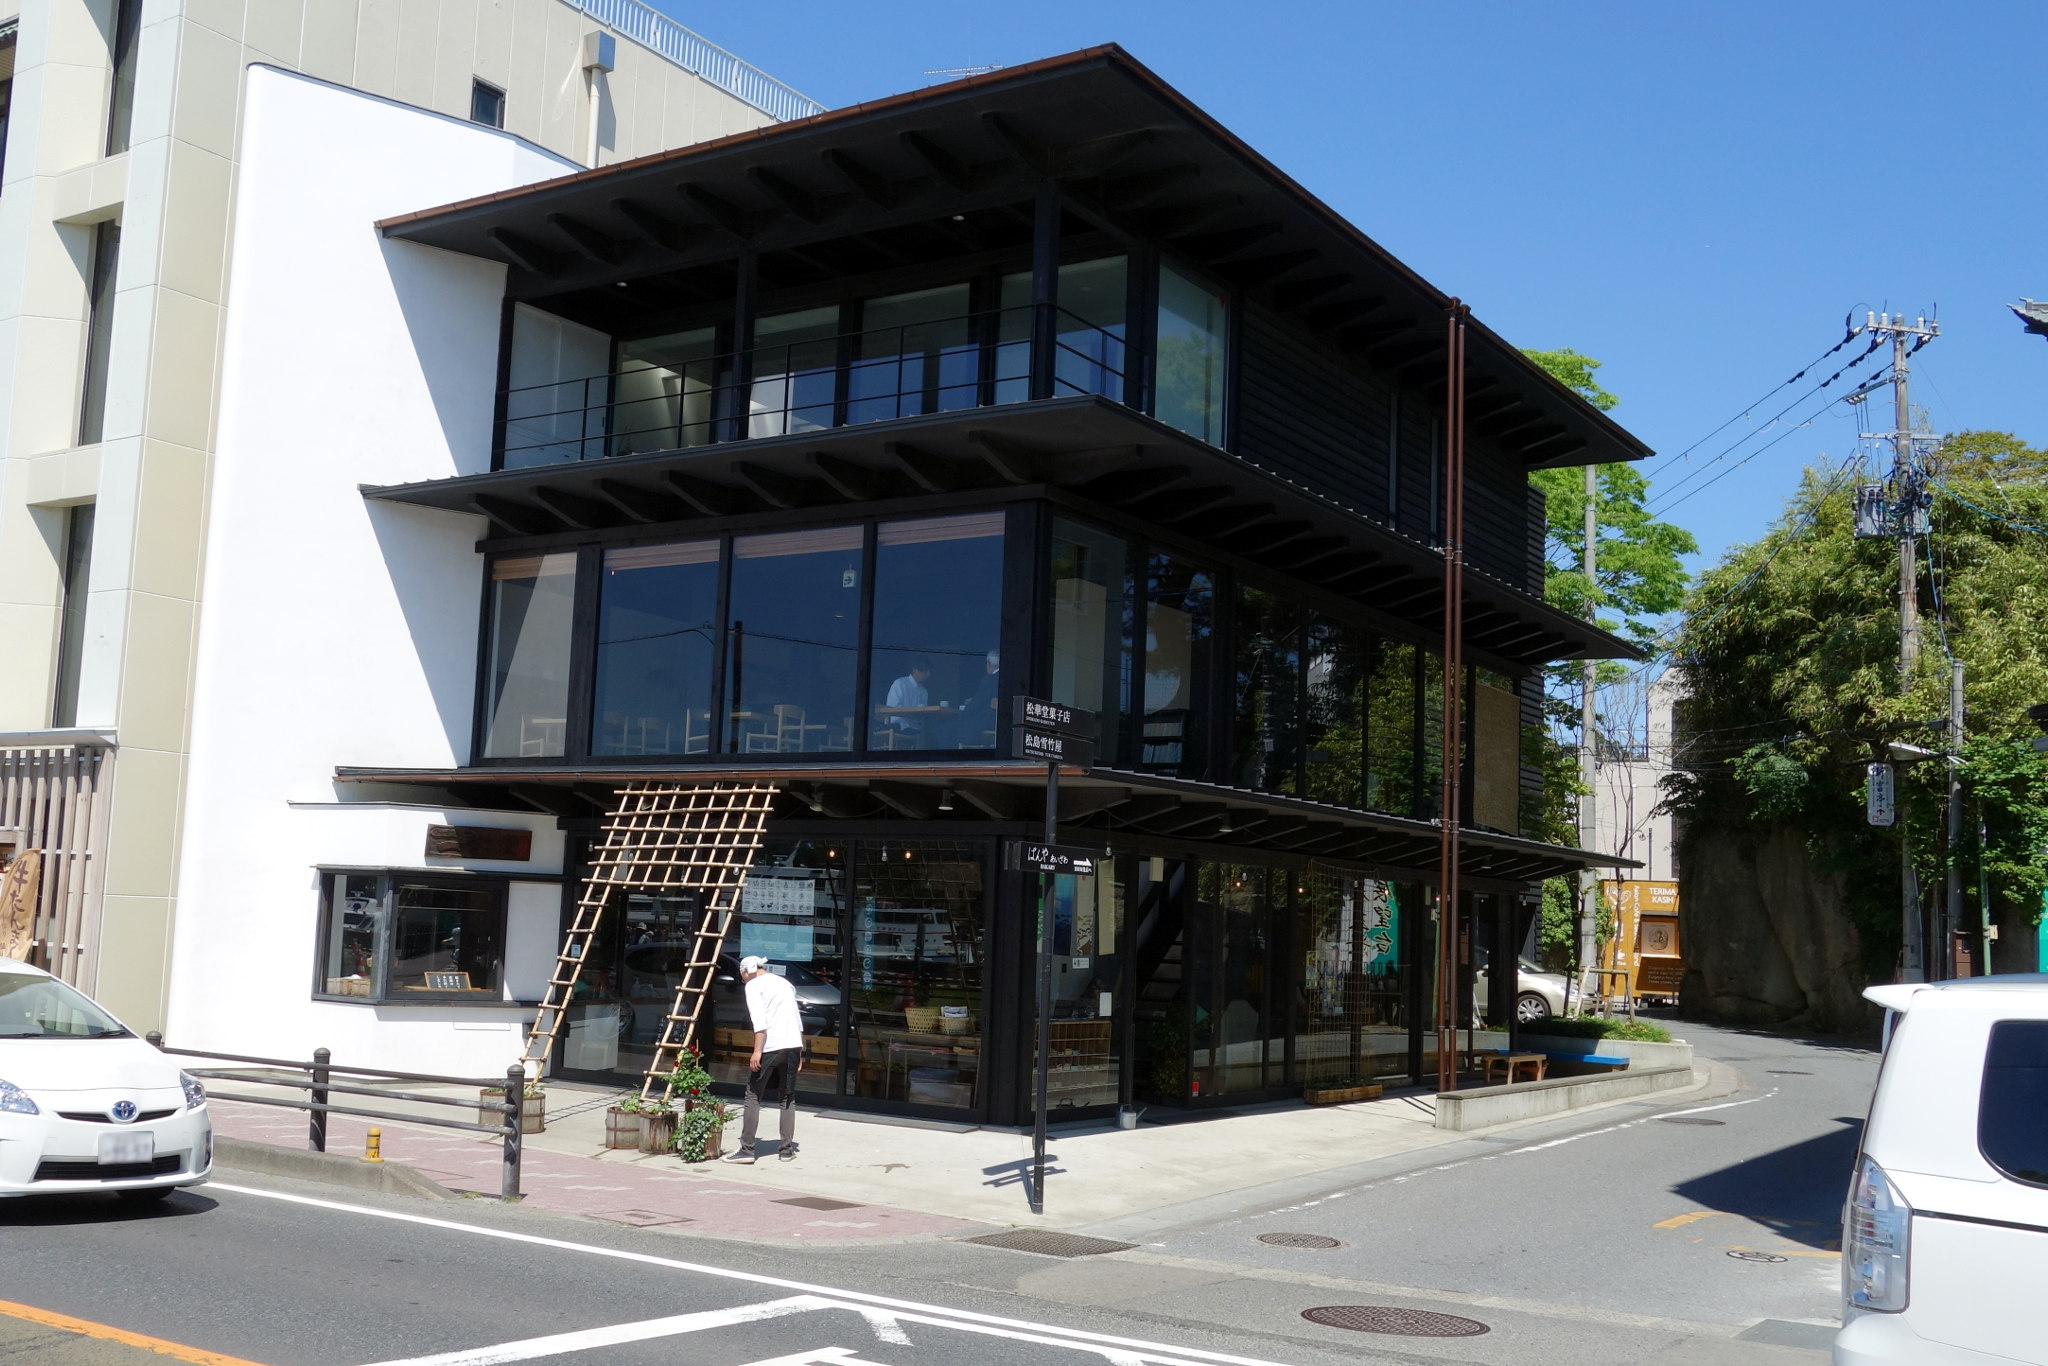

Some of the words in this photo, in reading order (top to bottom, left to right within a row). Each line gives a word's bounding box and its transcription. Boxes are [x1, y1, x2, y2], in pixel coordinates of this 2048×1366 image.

[1026, 701, 1071, 724] 松華堂菓子店
[1025, 733, 1063, 753] 松島雪竹屋
[1649, 887, 1676, 896] TERIMA
[1651, 895, 1674, 904] KASIH
